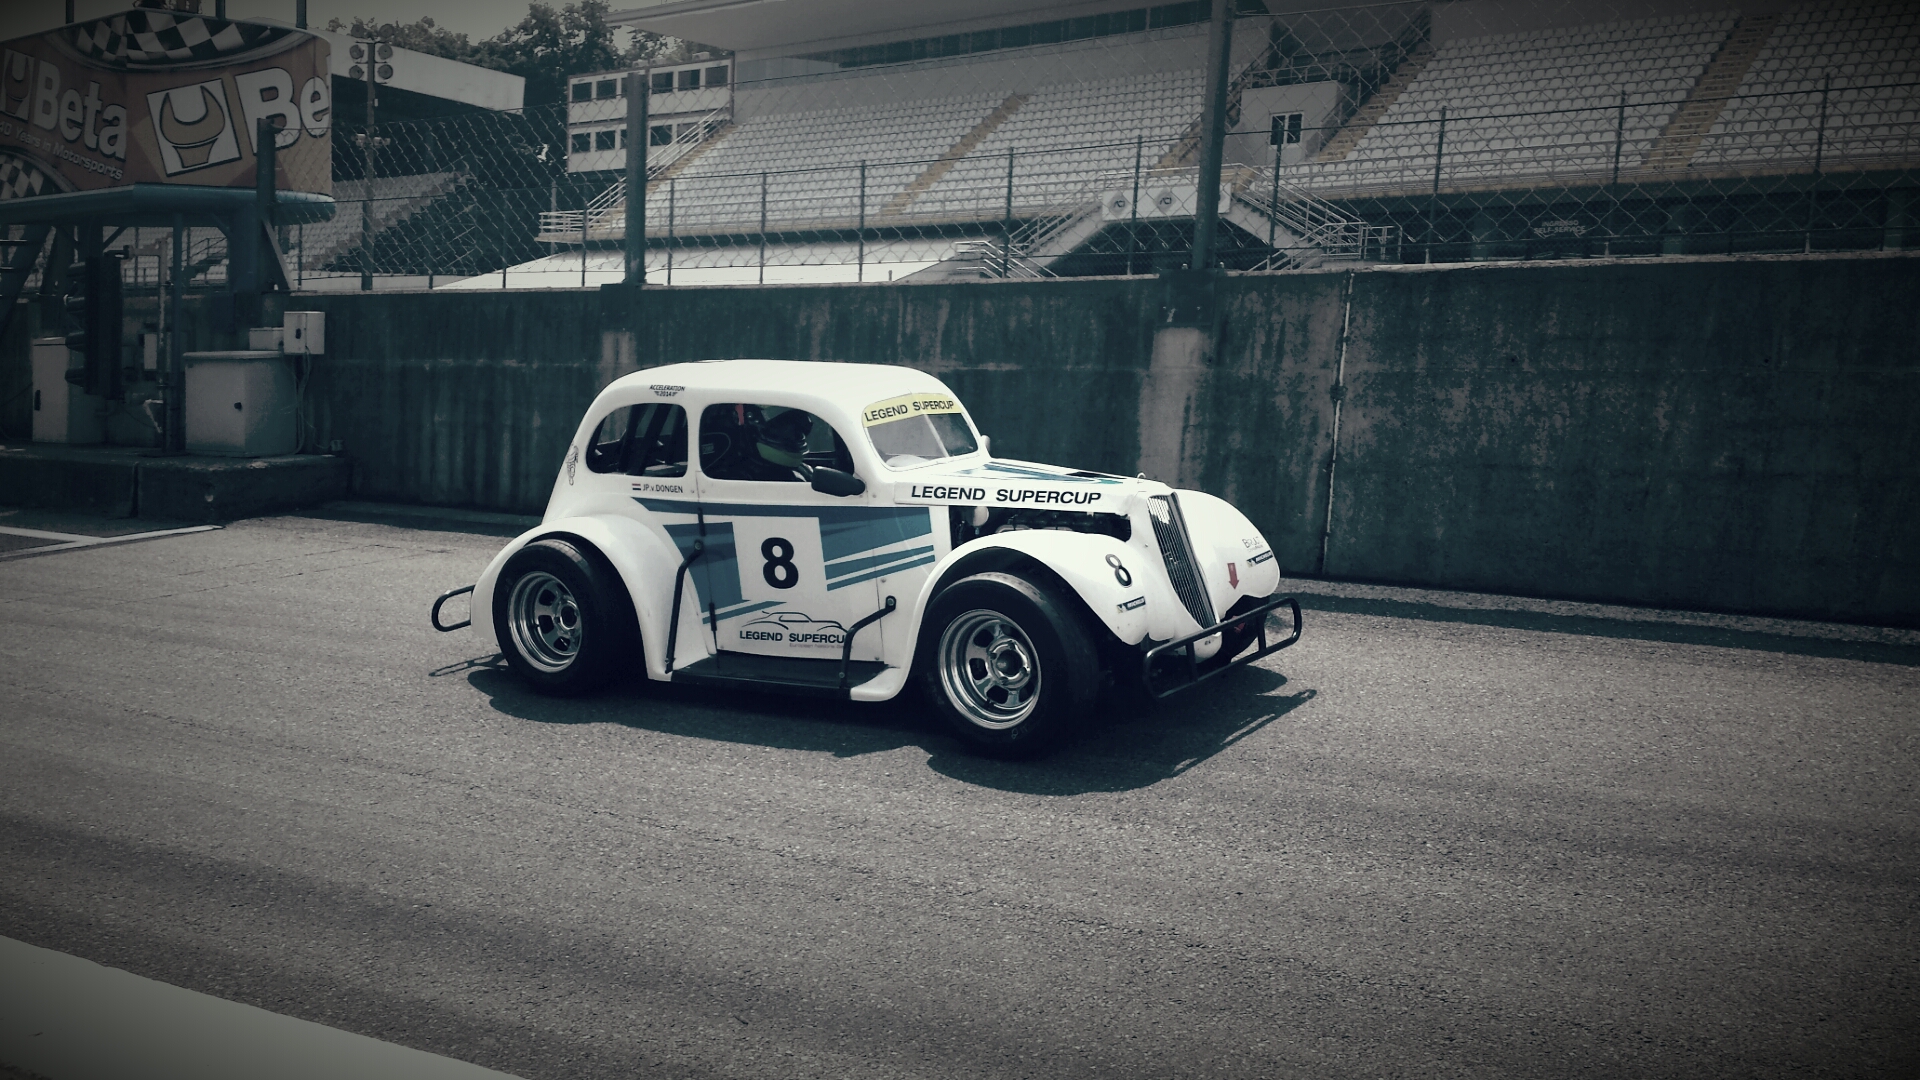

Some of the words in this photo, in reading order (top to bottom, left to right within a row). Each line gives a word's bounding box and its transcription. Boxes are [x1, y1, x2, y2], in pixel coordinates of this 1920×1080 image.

[33, 60, 127, 162] Beta
[234, 66, 331, 157] Be
[15, 126, 41, 149] Years
[42, 138, 51, 153] in
[53, 142, 124, 180] Motorsports
[864, 404, 908, 422] LEGEND
[912, 400, 954, 411] SUPERCUP
[910, 485, 986, 501] LEGEND
[995, 489, 1102, 505] SUPERCUP
[760, 537, 800, 590] 8
[1105, 553, 1132, 587] 8
[739, 630, 783, 641] LEGEND
[788, 633, 845, 644] SUPERCU
